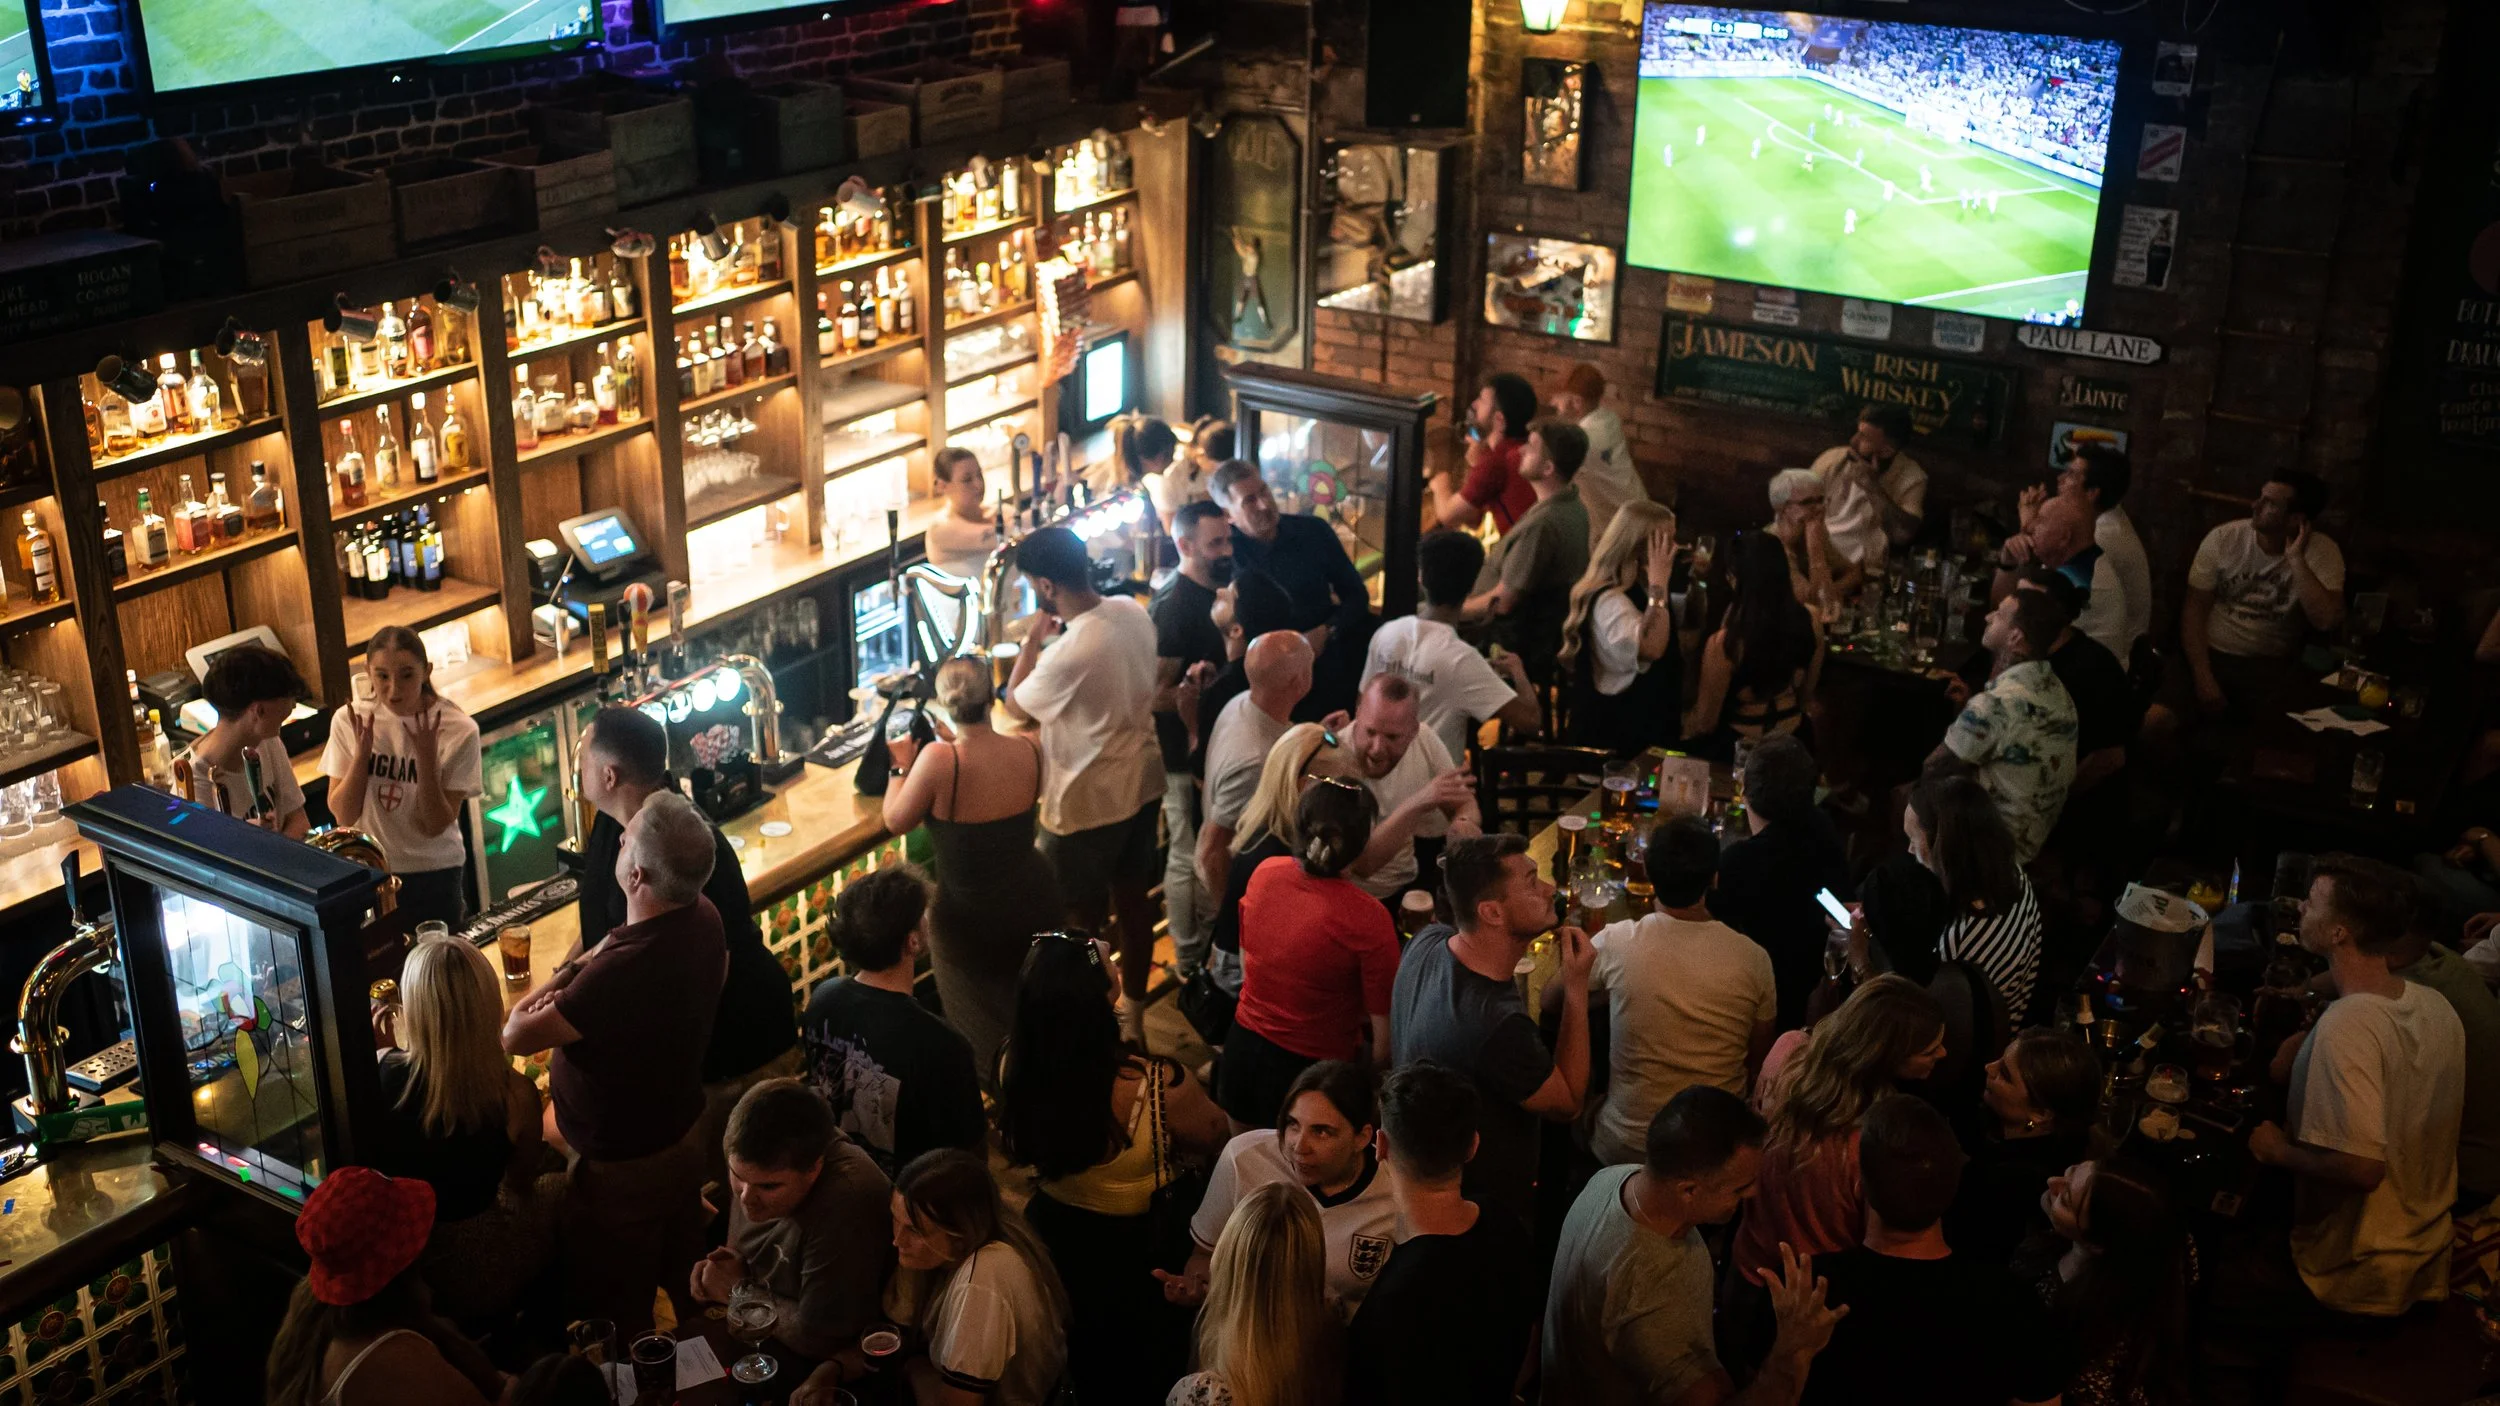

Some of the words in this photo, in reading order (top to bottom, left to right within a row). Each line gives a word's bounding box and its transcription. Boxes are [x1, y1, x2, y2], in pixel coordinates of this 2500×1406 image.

[1672, 323, 1818, 372] JAMESON
[2029, 325, 2083, 351] PAUL
[2091, 333, 2151, 361] LANE
[1873, 352, 1941, 383] IRISH
[1840, 365, 1955, 415] WHISKEY
[367, 753, 418, 784] NGLAN
